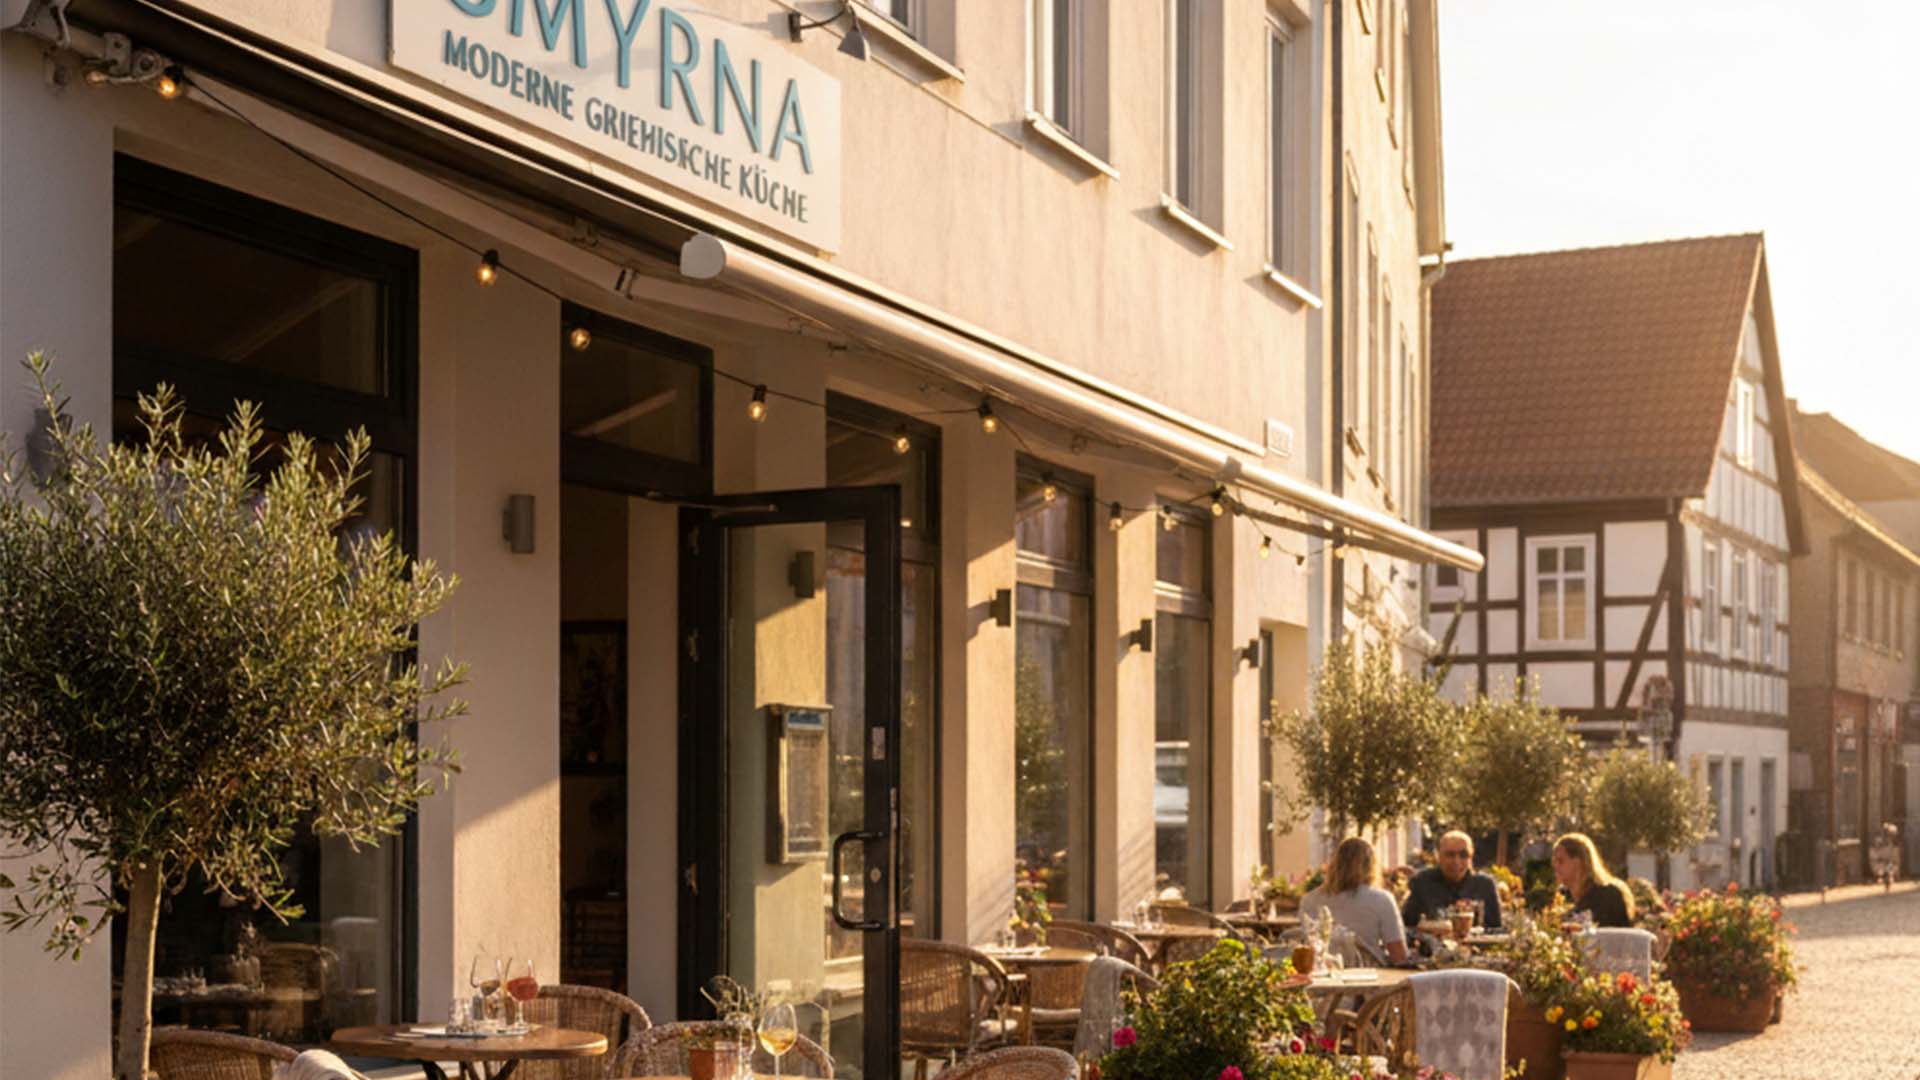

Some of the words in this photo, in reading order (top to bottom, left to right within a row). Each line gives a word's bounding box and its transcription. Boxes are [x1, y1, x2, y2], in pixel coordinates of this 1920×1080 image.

[444, 29, 574, 121] MODERNE
[740, 164, 808, 223] KÜCHE
[449, 0, 814, 174] MYRNA
